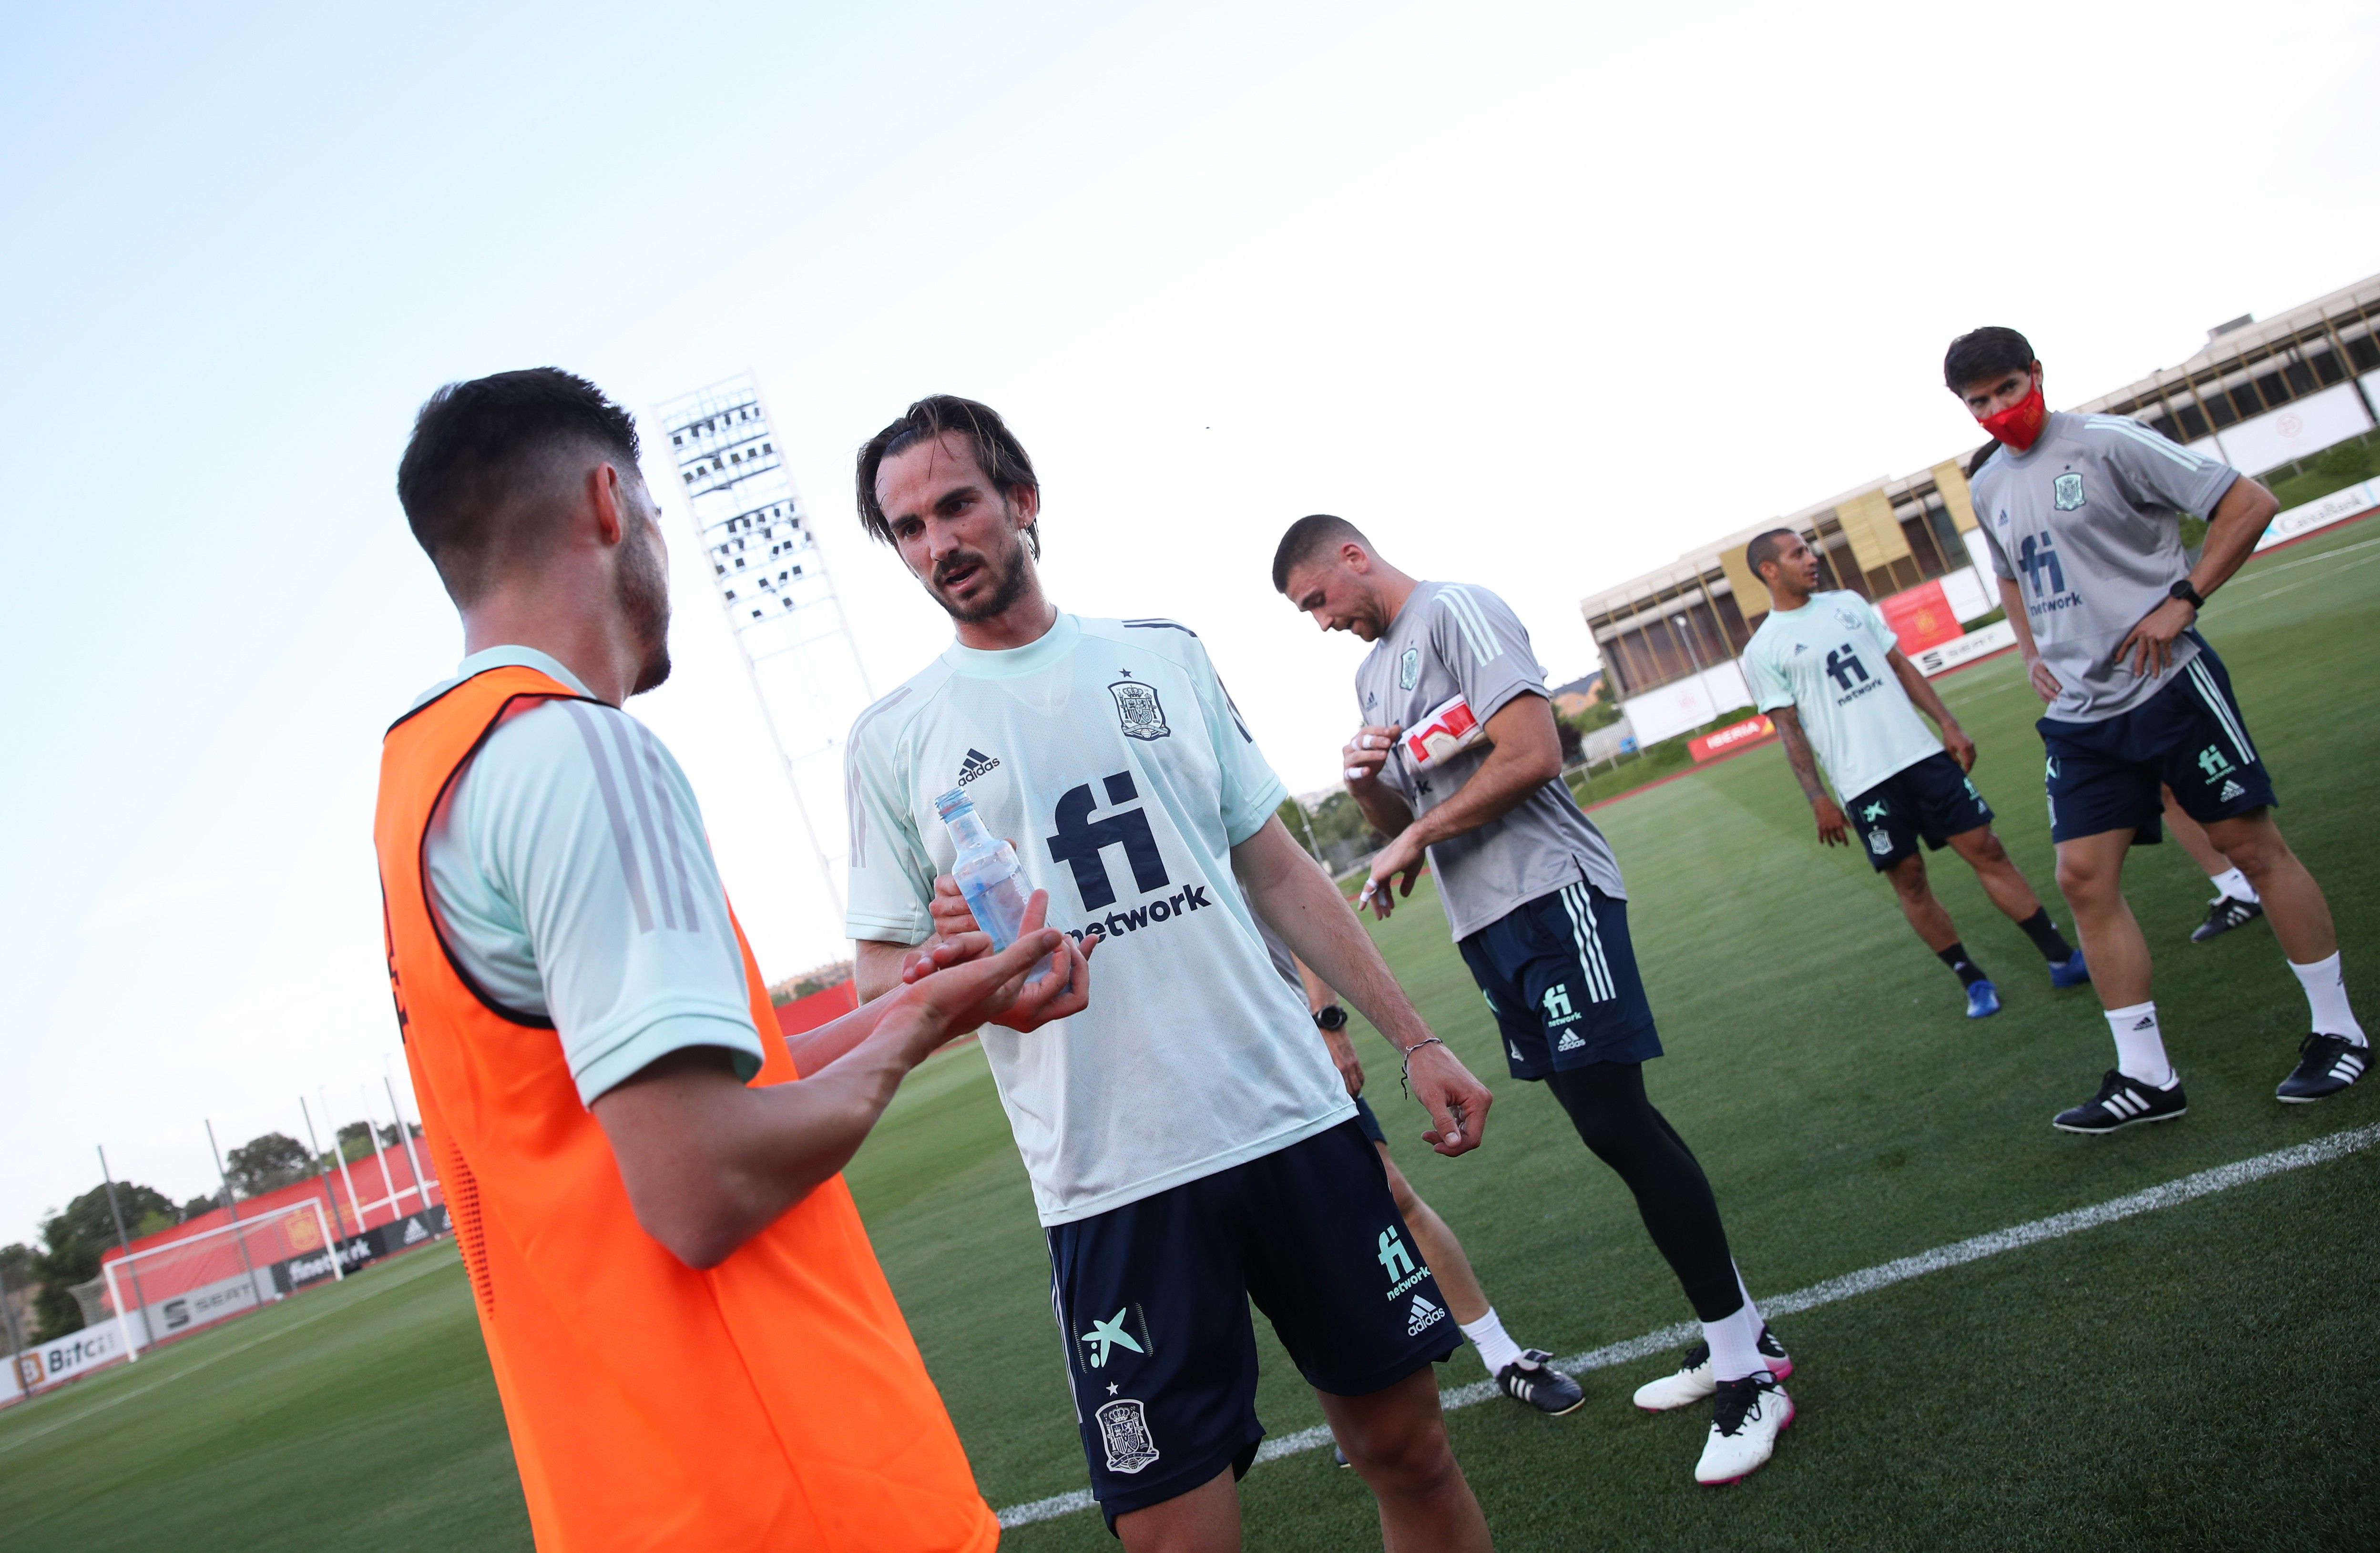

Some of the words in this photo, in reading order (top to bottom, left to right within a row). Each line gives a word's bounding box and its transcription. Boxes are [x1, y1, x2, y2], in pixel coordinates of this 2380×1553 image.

[2018, 530, 2065, 598] fi
[2030, 591, 2083, 617] network
[1827, 643, 1869, 690] fi
[1838, 678, 1884, 706] network
[1706, 721, 1760, 750] IBERIA
[958, 757, 1000, 786] adidas
[2197, 743, 2228, 776] fi
[1046, 770, 1170, 913] fi
[1542, 983, 1573, 1019] fi
[1548, 1011, 1583, 1028] network
[1558, 1038, 1586, 1052] adidas
[1378, 1225, 1415, 1284] fi
[195, 1283, 251, 1313] SEAT
[1387, 1266, 1431, 1301] network
[1408, 1307, 1445, 1337] adidas
